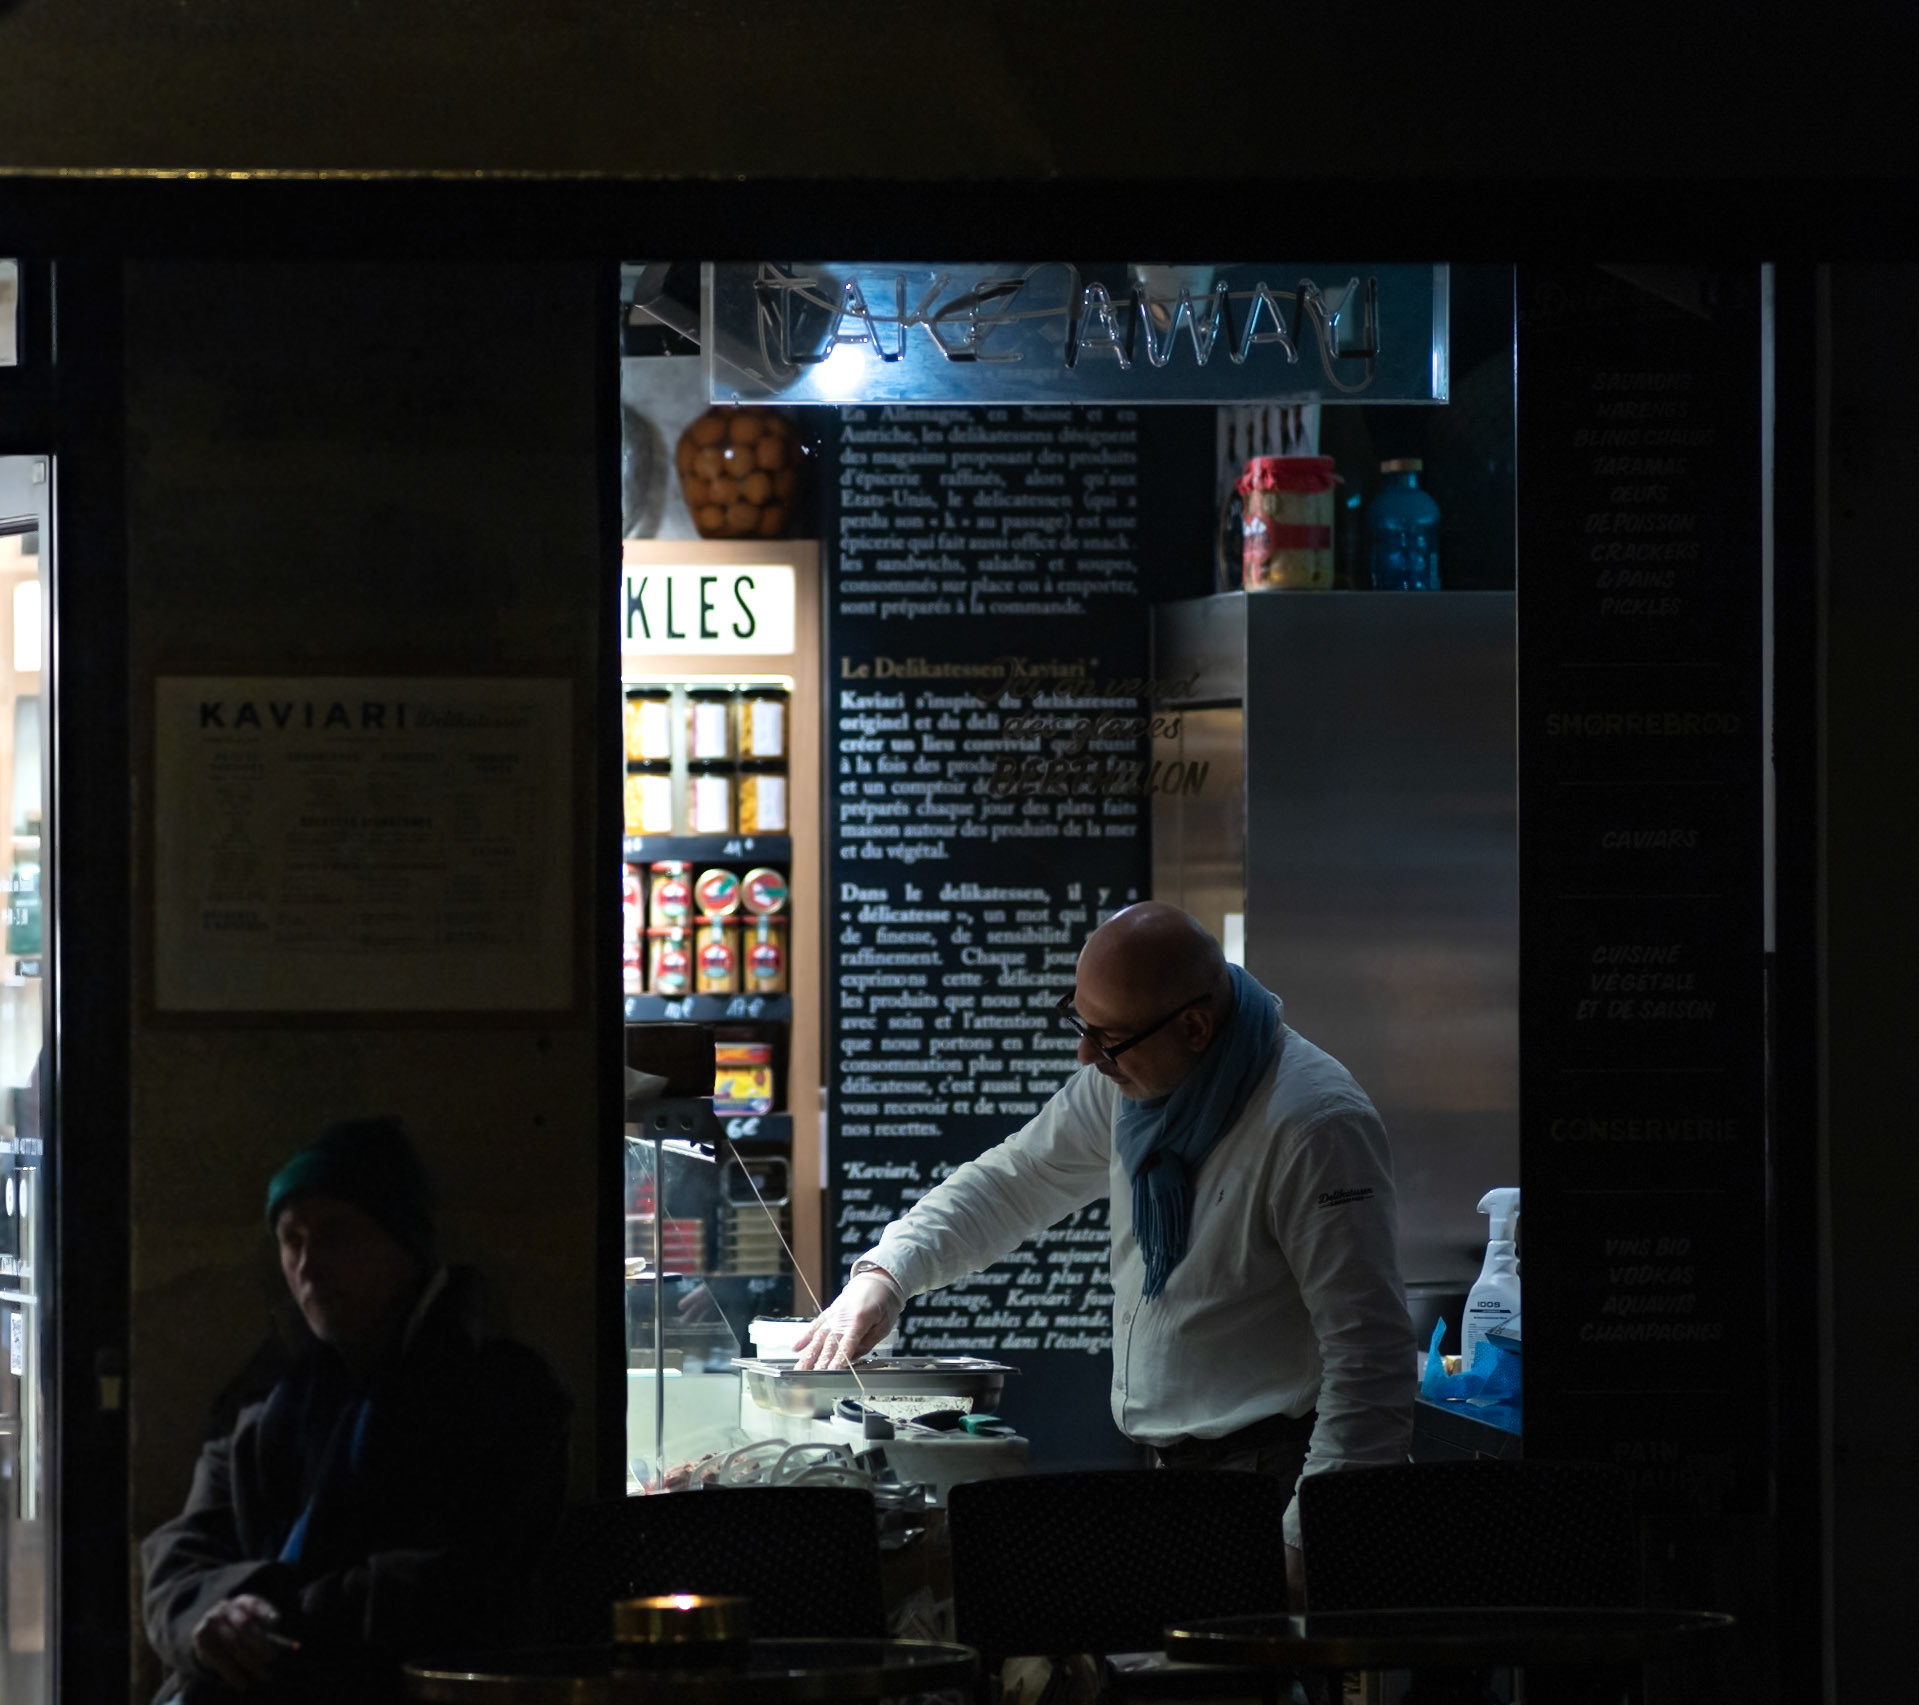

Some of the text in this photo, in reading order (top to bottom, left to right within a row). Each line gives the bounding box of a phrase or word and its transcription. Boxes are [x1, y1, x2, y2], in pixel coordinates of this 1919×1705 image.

[1064, 277, 1380, 370] AWAY
[1584, 512, 1698, 534] DE POISSON
[1589, 541, 1701, 562] CRACKERS
[1614, 569, 1677, 589] PAINS
[1599, 596, 1683, 617] PICKLES
[840, 657, 870, 678] Le
[874, 657, 1005, 678] Delikatessen
[839, 691, 905, 709] Kaviari
[199, 700, 407, 730] KAVIARI
[914, 715, 932, 730] et
[937, 712, 961, 730] du
[839, 734, 884, 752] créer
[890, 740, 915, 752] un
[922, 734, 956, 752] lieu
[963, 734, 1042, 752] convivial
[855, 755, 872, 773] la
[876, 755, 908, 773] fois
[913, 755, 940, 773] des
[839, 780, 858, 795] et
[862, 783, 886, 795] un
[891, 777, 966, 801] comptoir
[839, 798, 1137, 822] préparés chaque jour des plats faits
[840, 819, 1137, 843] maison autour des produits de la mer
[1600, 828, 1699, 850] CAVIARS
[839, 841, 949, 865] et du végétal.
[839, 883, 888, 901] Dans
[905, 883, 922, 901] le
[939, 883, 1050, 904] delikatessen,
[1067, 883, 1082, 901] il
[1098, 889, 1112, 907] y
[857, 905, 951, 923] délicatesse
[983, 911, 1006, 923] un
[1015, 908, 1050, 923] mot
[1058, 905, 1088, 929] qui
[840, 926, 1071, 947] de finesse, de sensibilité
[840, 948, 1027, 972] raffinement. Chaque
[1591, 943, 1683, 965] CUISINE
[840, 969, 983, 993] exprimons cette
[1589, 967, 1697, 993] VÉGÉTALE
[840, 990, 1022, 1014] les produits que nous
[1575, 999, 1717, 1021] ET DE SAISON
[840, 1011, 1048, 1029] avec soin et l'attention
[840, 1036, 1023, 1057] que nous portons en
[840, 1054, 1003, 1078] consommation plus
[840, 1076, 1058, 1097] délicatesse, c'est aussi une
[840, 1097, 1037, 1115] vous recevoir et de vous
[841, 1122, 943, 1137] nos recettes.
[1549, 1118, 1740, 1143] CONSERVERIE
[1604, 1236, 1692, 1258] VINS BIO
[1015, 1267, 1043, 1285] des
[1047, 1267, 1085, 1291] plus
[1608, 1264, 1696, 1286] VODKAS
[1004, 1289, 1071, 1307] Kaviari
[1477, 1300, 1501, 1308] IDOS
[904, 1310, 969, 1334] grandes
[974, 1310, 1022, 1328] tables
[1025, 1310, 1049, 1328] du
[1578, 1321, 1723, 1343] CHAMPAGNES
[911, 1331, 1039, 1349] résolument dans
